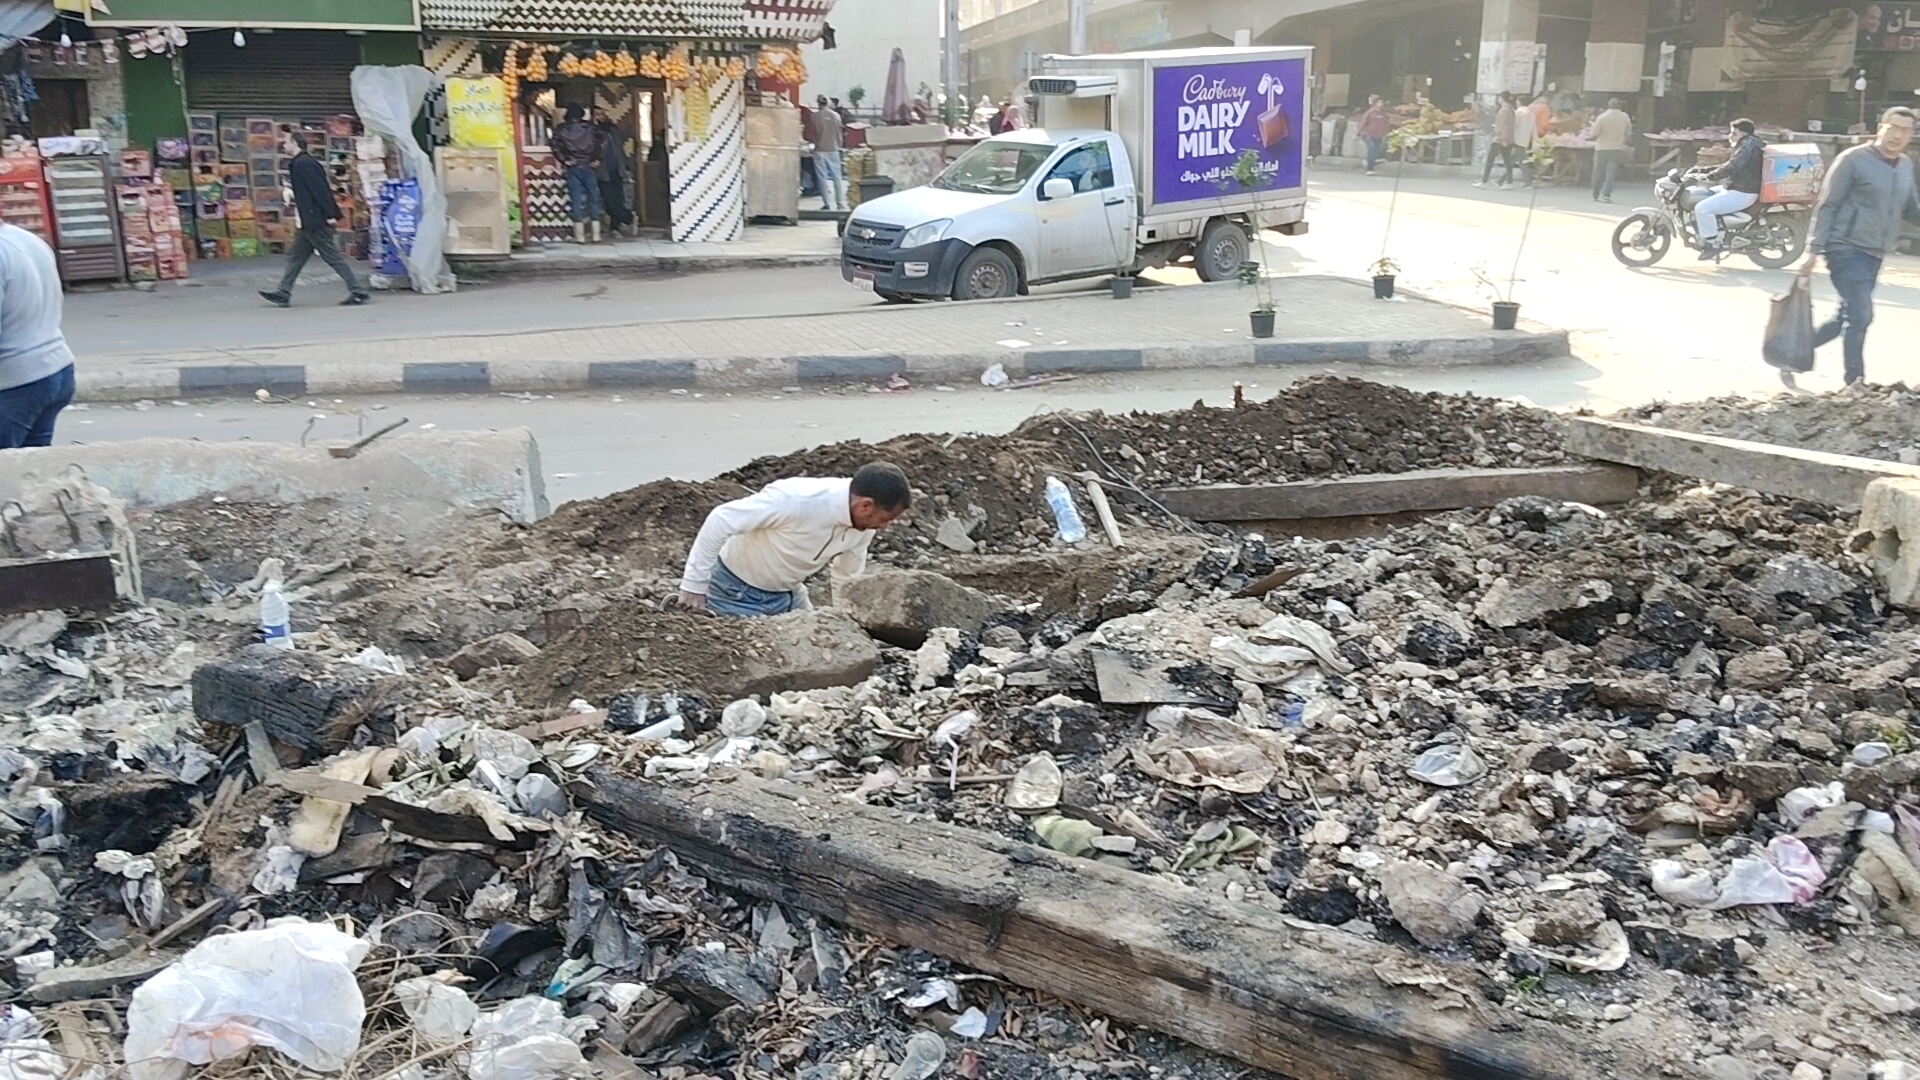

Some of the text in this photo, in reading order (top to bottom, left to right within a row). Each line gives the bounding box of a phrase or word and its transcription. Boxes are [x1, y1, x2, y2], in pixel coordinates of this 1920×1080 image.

[1183, 74, 1247, 104] Cadbury
[1178, 101, 1251, 132] DAIRY
[1178, 129, 1236, 159] MILK
[1180, 170, 1201, 183] جواك
[1202, 166, 1220, 182] اللي
